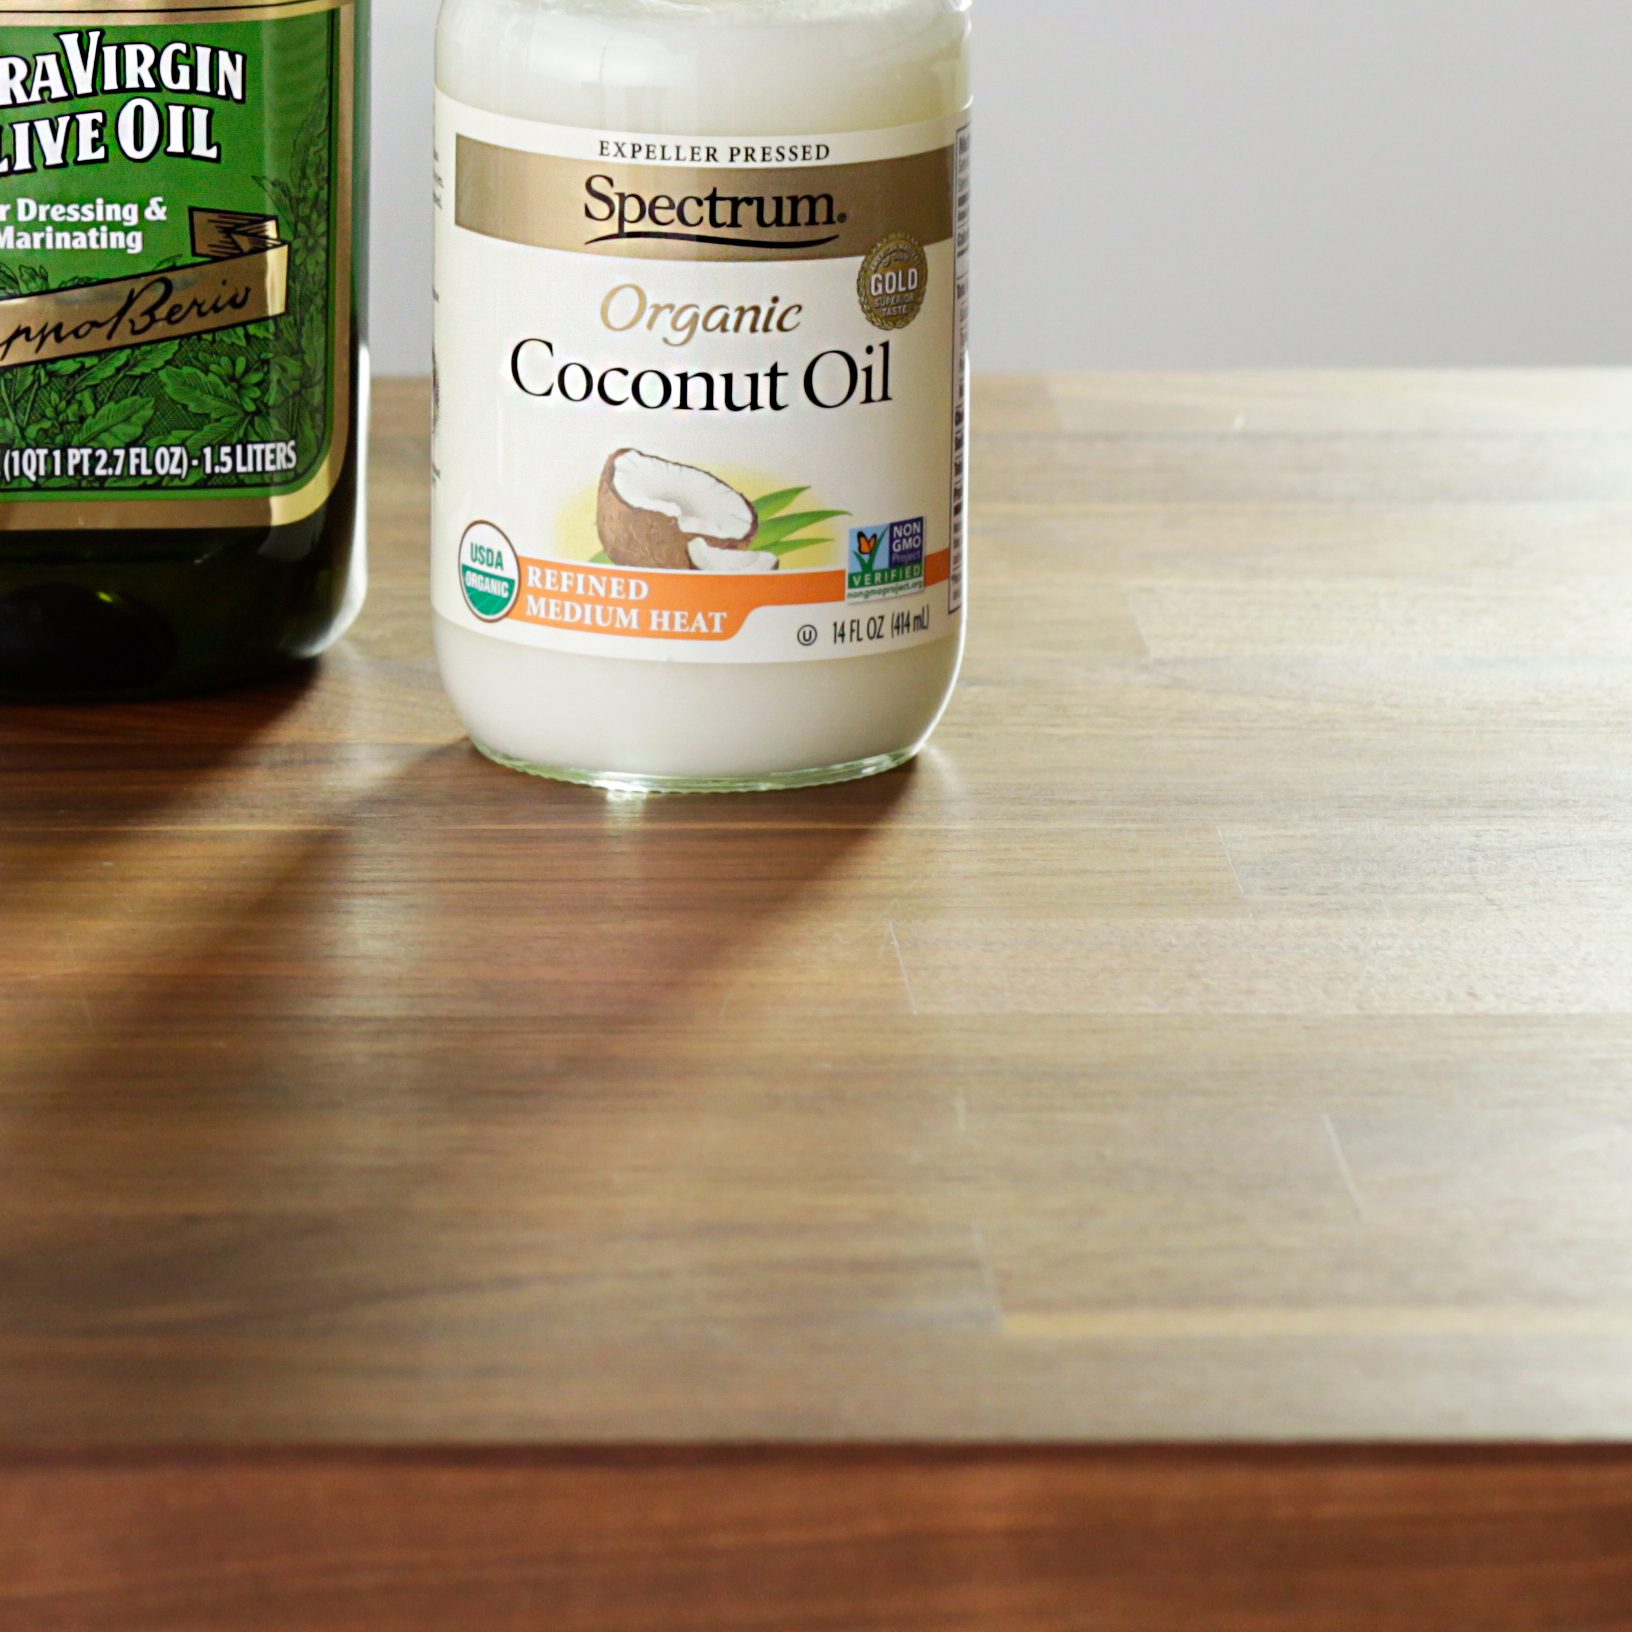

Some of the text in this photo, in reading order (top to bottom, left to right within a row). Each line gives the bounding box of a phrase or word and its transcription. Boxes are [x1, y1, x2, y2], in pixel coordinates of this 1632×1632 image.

[598, 139, 831, 165] EXPELLER PRESSED
[16, 197, 140, 228] Dressing
[144, 197, 169, 222] &
[584, 174, 835, 236] Spectrum
[870, 268, 918, 296] GOLD
[599, 281, 802, 348] Organic
[509, 338, 894, 413] Coconut Oil
[67, 447, 93, 477] PT
[94, 447, 125, 476] 2.7
[128, 446, 152, 476] FL
[154, 445, 189, 480] OZ)
[202, 445, 234, 475] 1.5
[235, 439, 298, 474] LITERS
[892, 521, 921, 538] NON
[892, 535, 922, 553] GMO
[470, 541, 504, 572] USDA
[465, 569, 510, 600] ORGANIC
[526, 564, 650, 601] REFINED
[846, 579, 924, 600] nongmoproject.org
[852, 564, 921, 587] VERIFIED
[525, 594, 729, 634] MEDIUM HEAT
[832, 603, 930, 646] 14 FL OZ (414 mL)
